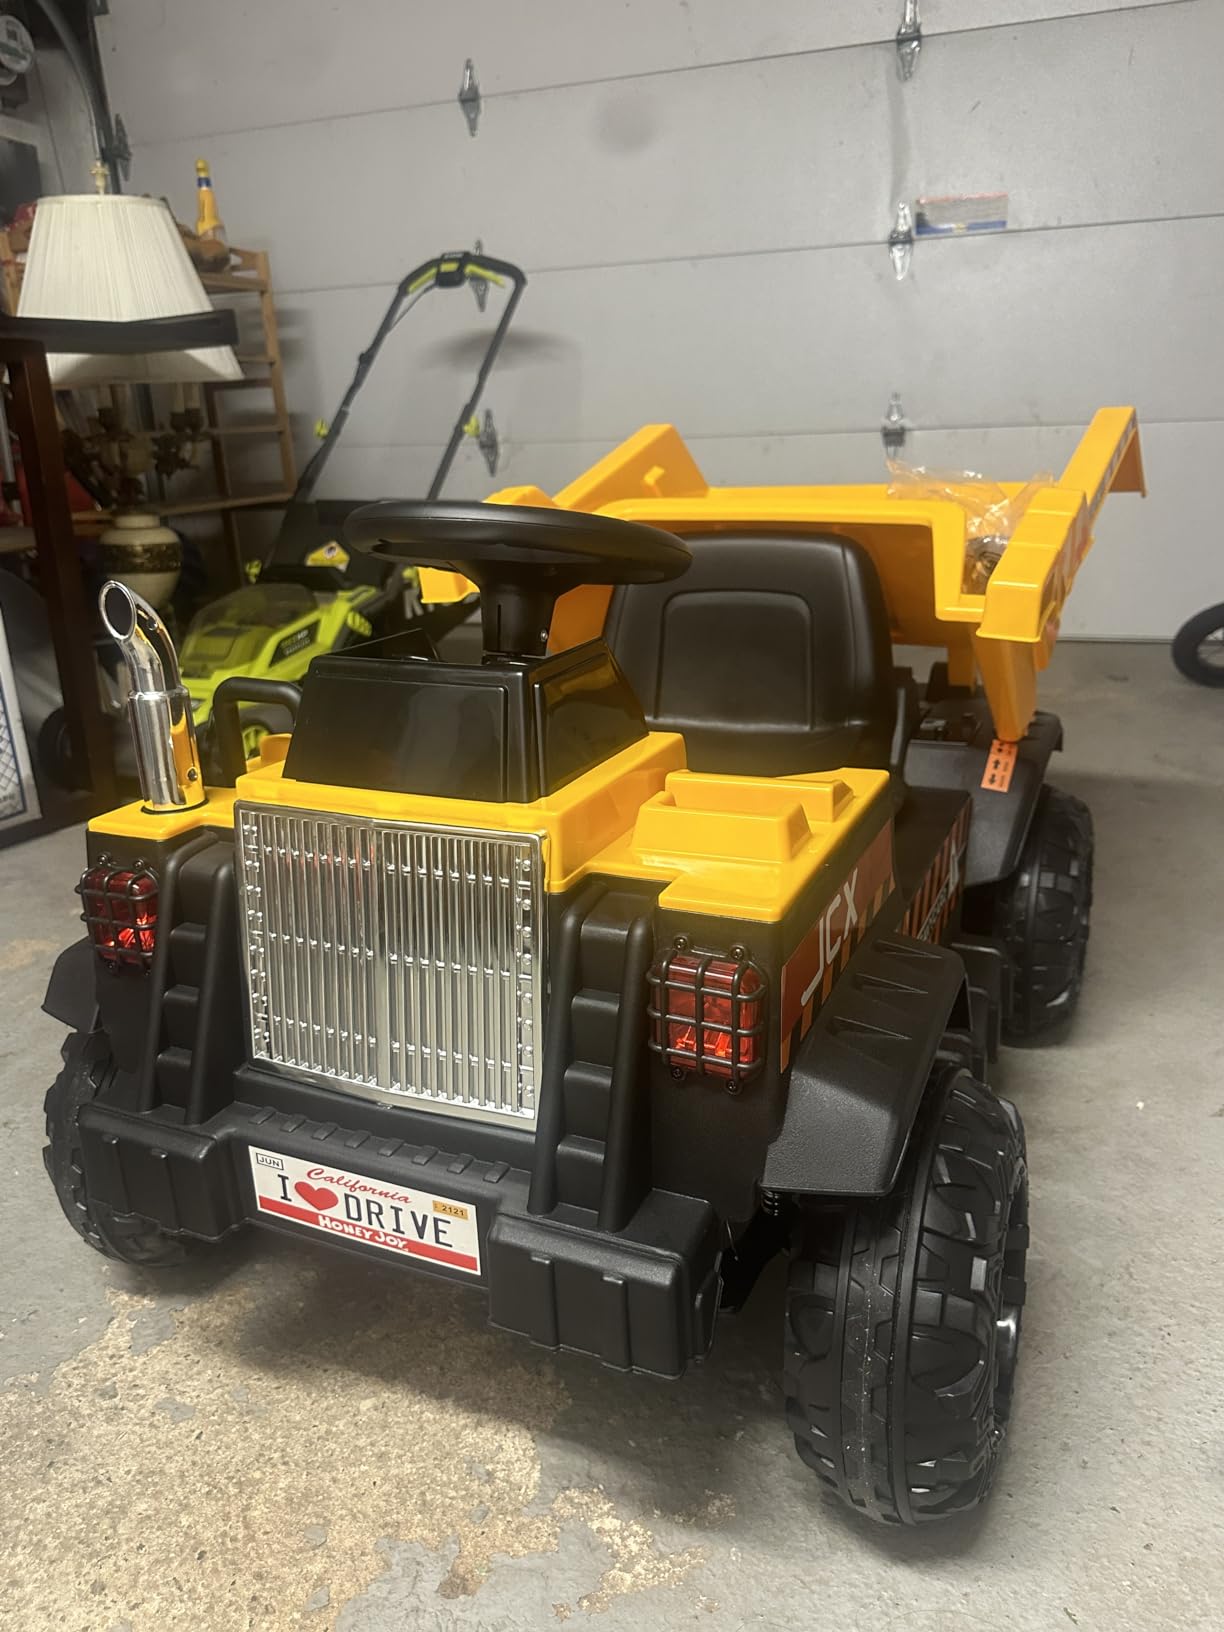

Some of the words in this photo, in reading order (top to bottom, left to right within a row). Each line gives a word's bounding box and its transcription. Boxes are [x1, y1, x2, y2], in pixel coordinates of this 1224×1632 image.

[800, 868, 858, 1006] JCX
[258, 1157, 281, 1168] JUN
[306, 1168, 412, 1203] California
[277, 1174, 292, 1202] I
[344, 1193, 453, 1248] DRIVE
[441, 1205, 465, 1217] 2121
[317, 1215, 372, 1239] HONEY
[374, 1231, 407, 1250] JOY
